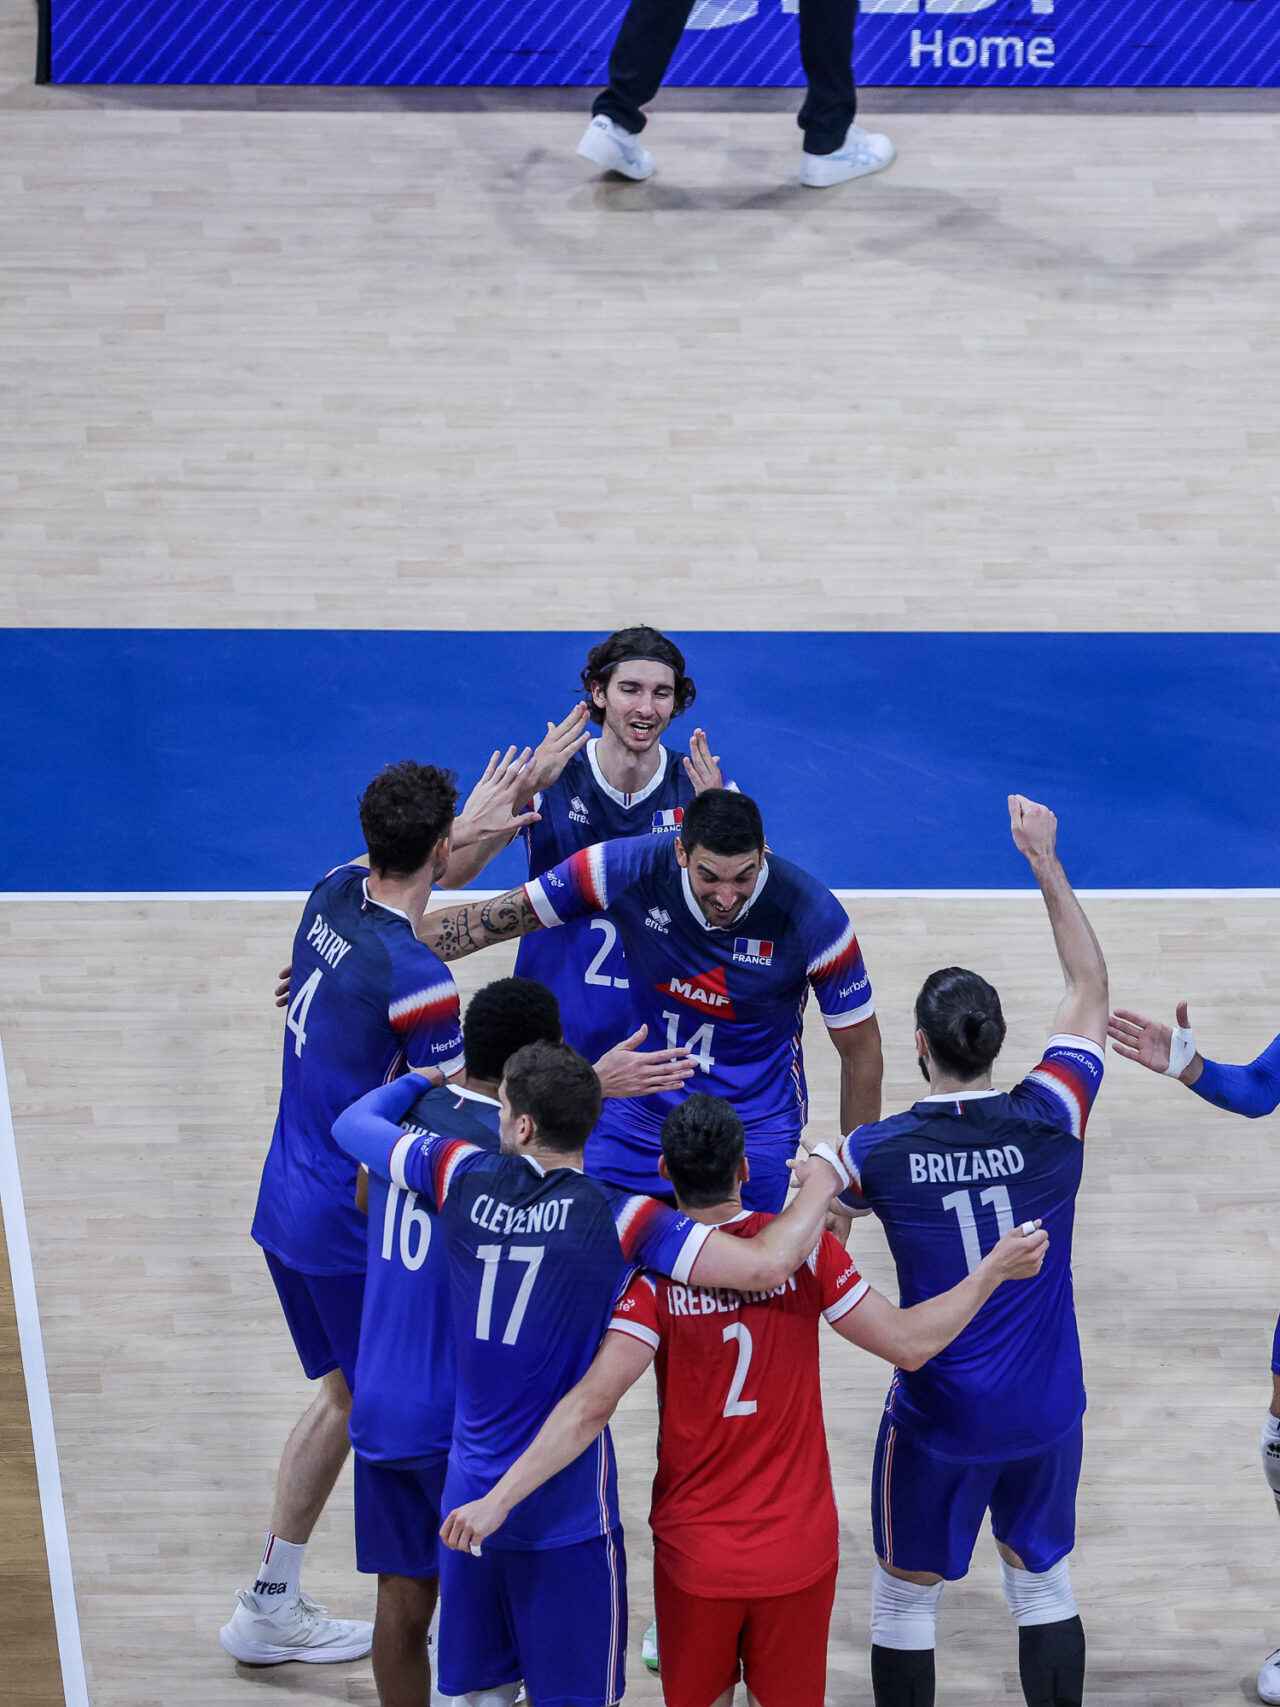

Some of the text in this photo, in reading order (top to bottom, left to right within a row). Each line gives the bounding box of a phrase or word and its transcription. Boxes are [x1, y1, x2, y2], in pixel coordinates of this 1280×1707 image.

[910, 29, 1056, 68] Home
[652, 825, 683, 835] FRANC
[306, 914, 352, 969] PATRY
[584, 918, 630, 989] 2
[732, 953, 772, 967] FRANCE
[286, 967, 324, 1058] 4
[669, 977, 730, 1007] MAIF
[662, 1010, 715, 1074] 14
[909, 1144, 1025, 1184] BRIZARD
[381, 1182, 432, 1271] 16
[470, 1194, 574, 1235] CLEVENOT
[942, 1185, 1016, 1275] 11
[475, 1244, 545, 1346] 17
[722, 1322, 757, 1418] 2
[253, 1580, 286, 1596] rrea
